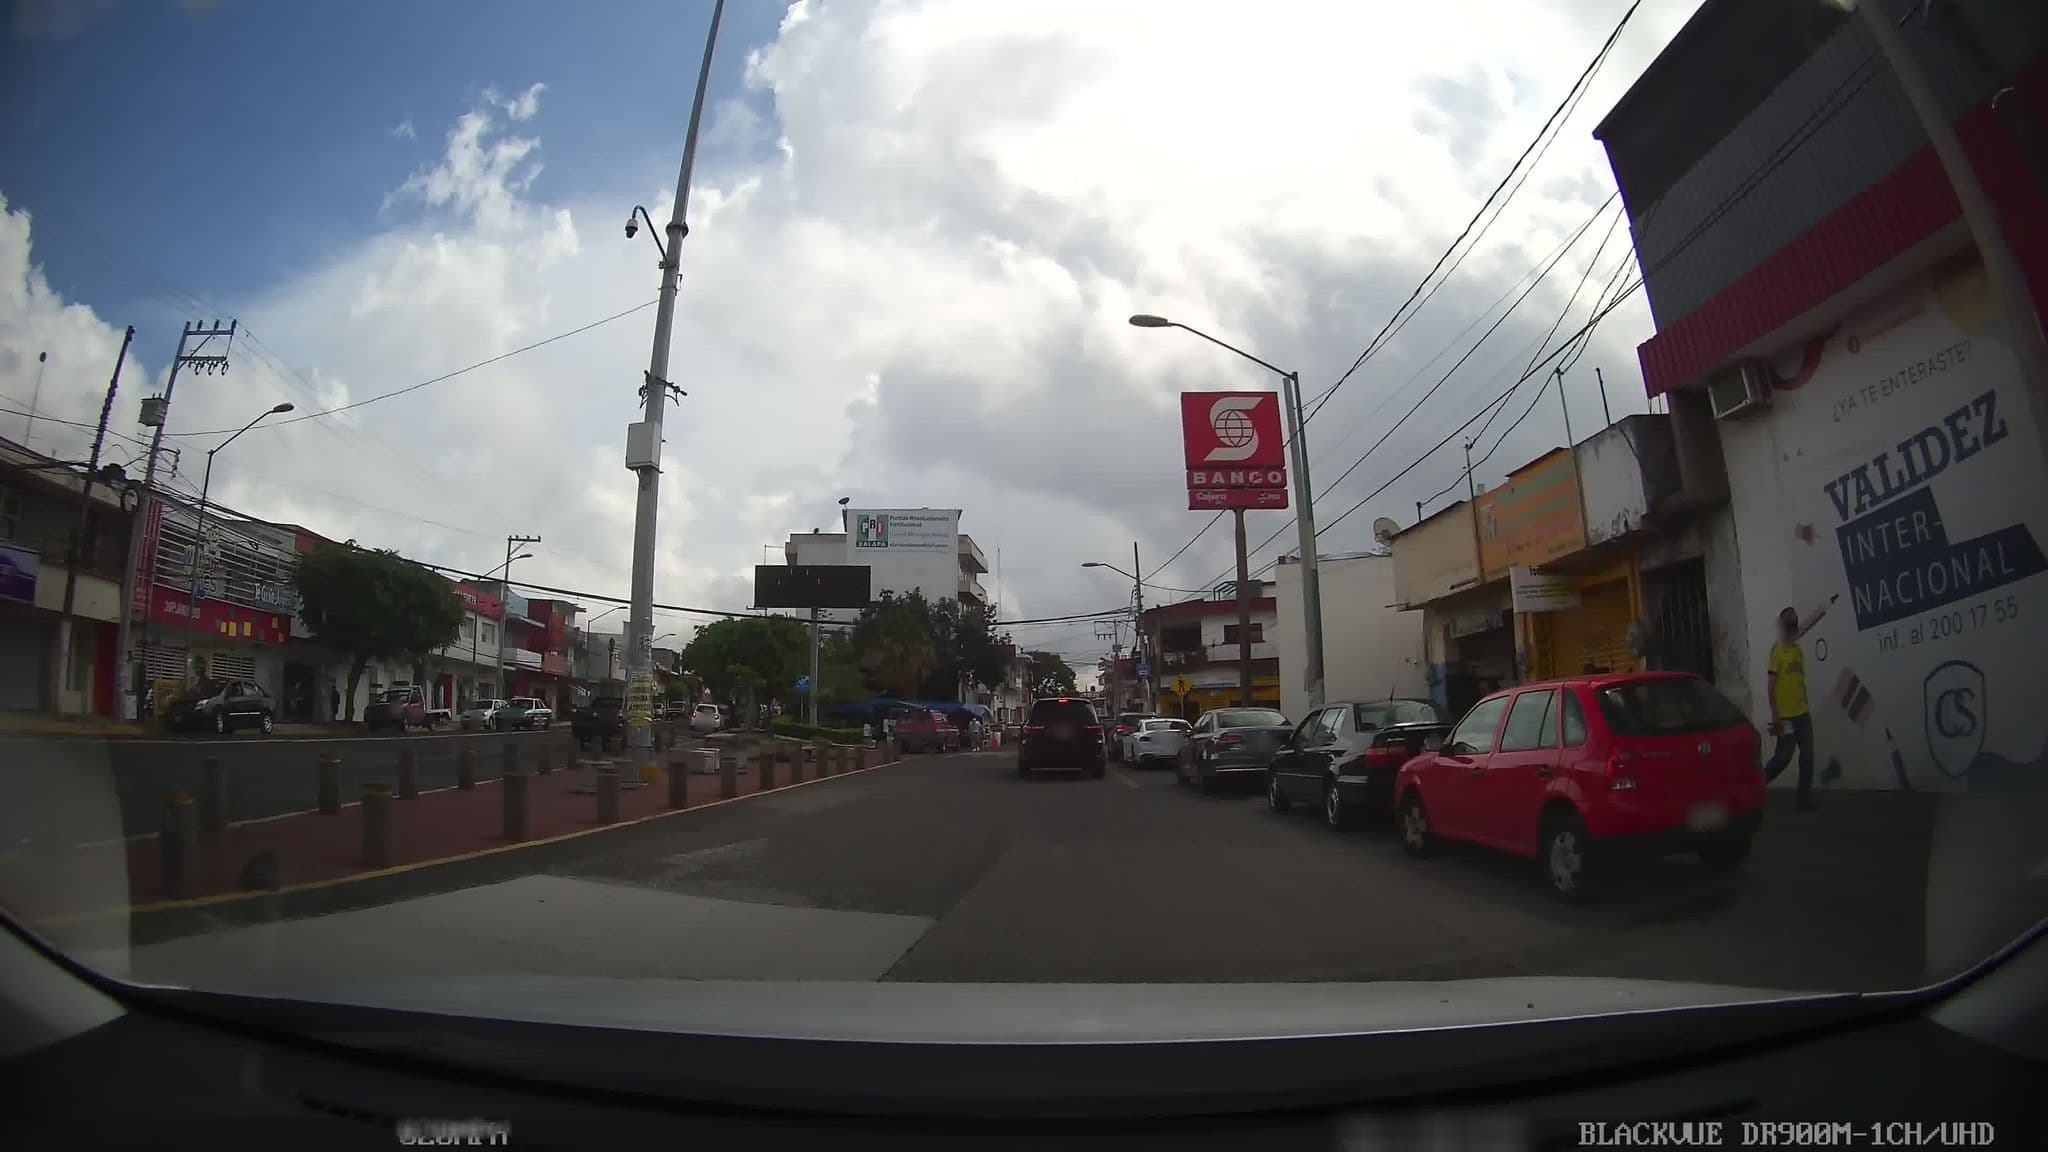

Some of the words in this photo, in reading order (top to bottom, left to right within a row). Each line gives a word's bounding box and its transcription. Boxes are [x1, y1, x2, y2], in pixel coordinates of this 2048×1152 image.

[1832, 395, 1857, 423] ¿YA
[1859, 384, 1879, 406] TE
[1879, 339, 1972, 399] ENTERASTE?
[1193, 471, 1282, 484] BANCO
[1824, 388, 2009, 522] VALIDEZ
[1846, 510, 1942, 564] INTER-
[1854, 541, 2016, 615] NACIONAL
[1911, 622, 1924, 645] al
[1929, 611, 1963, 641] 200
[1970, 604, 1987, 631] 17
